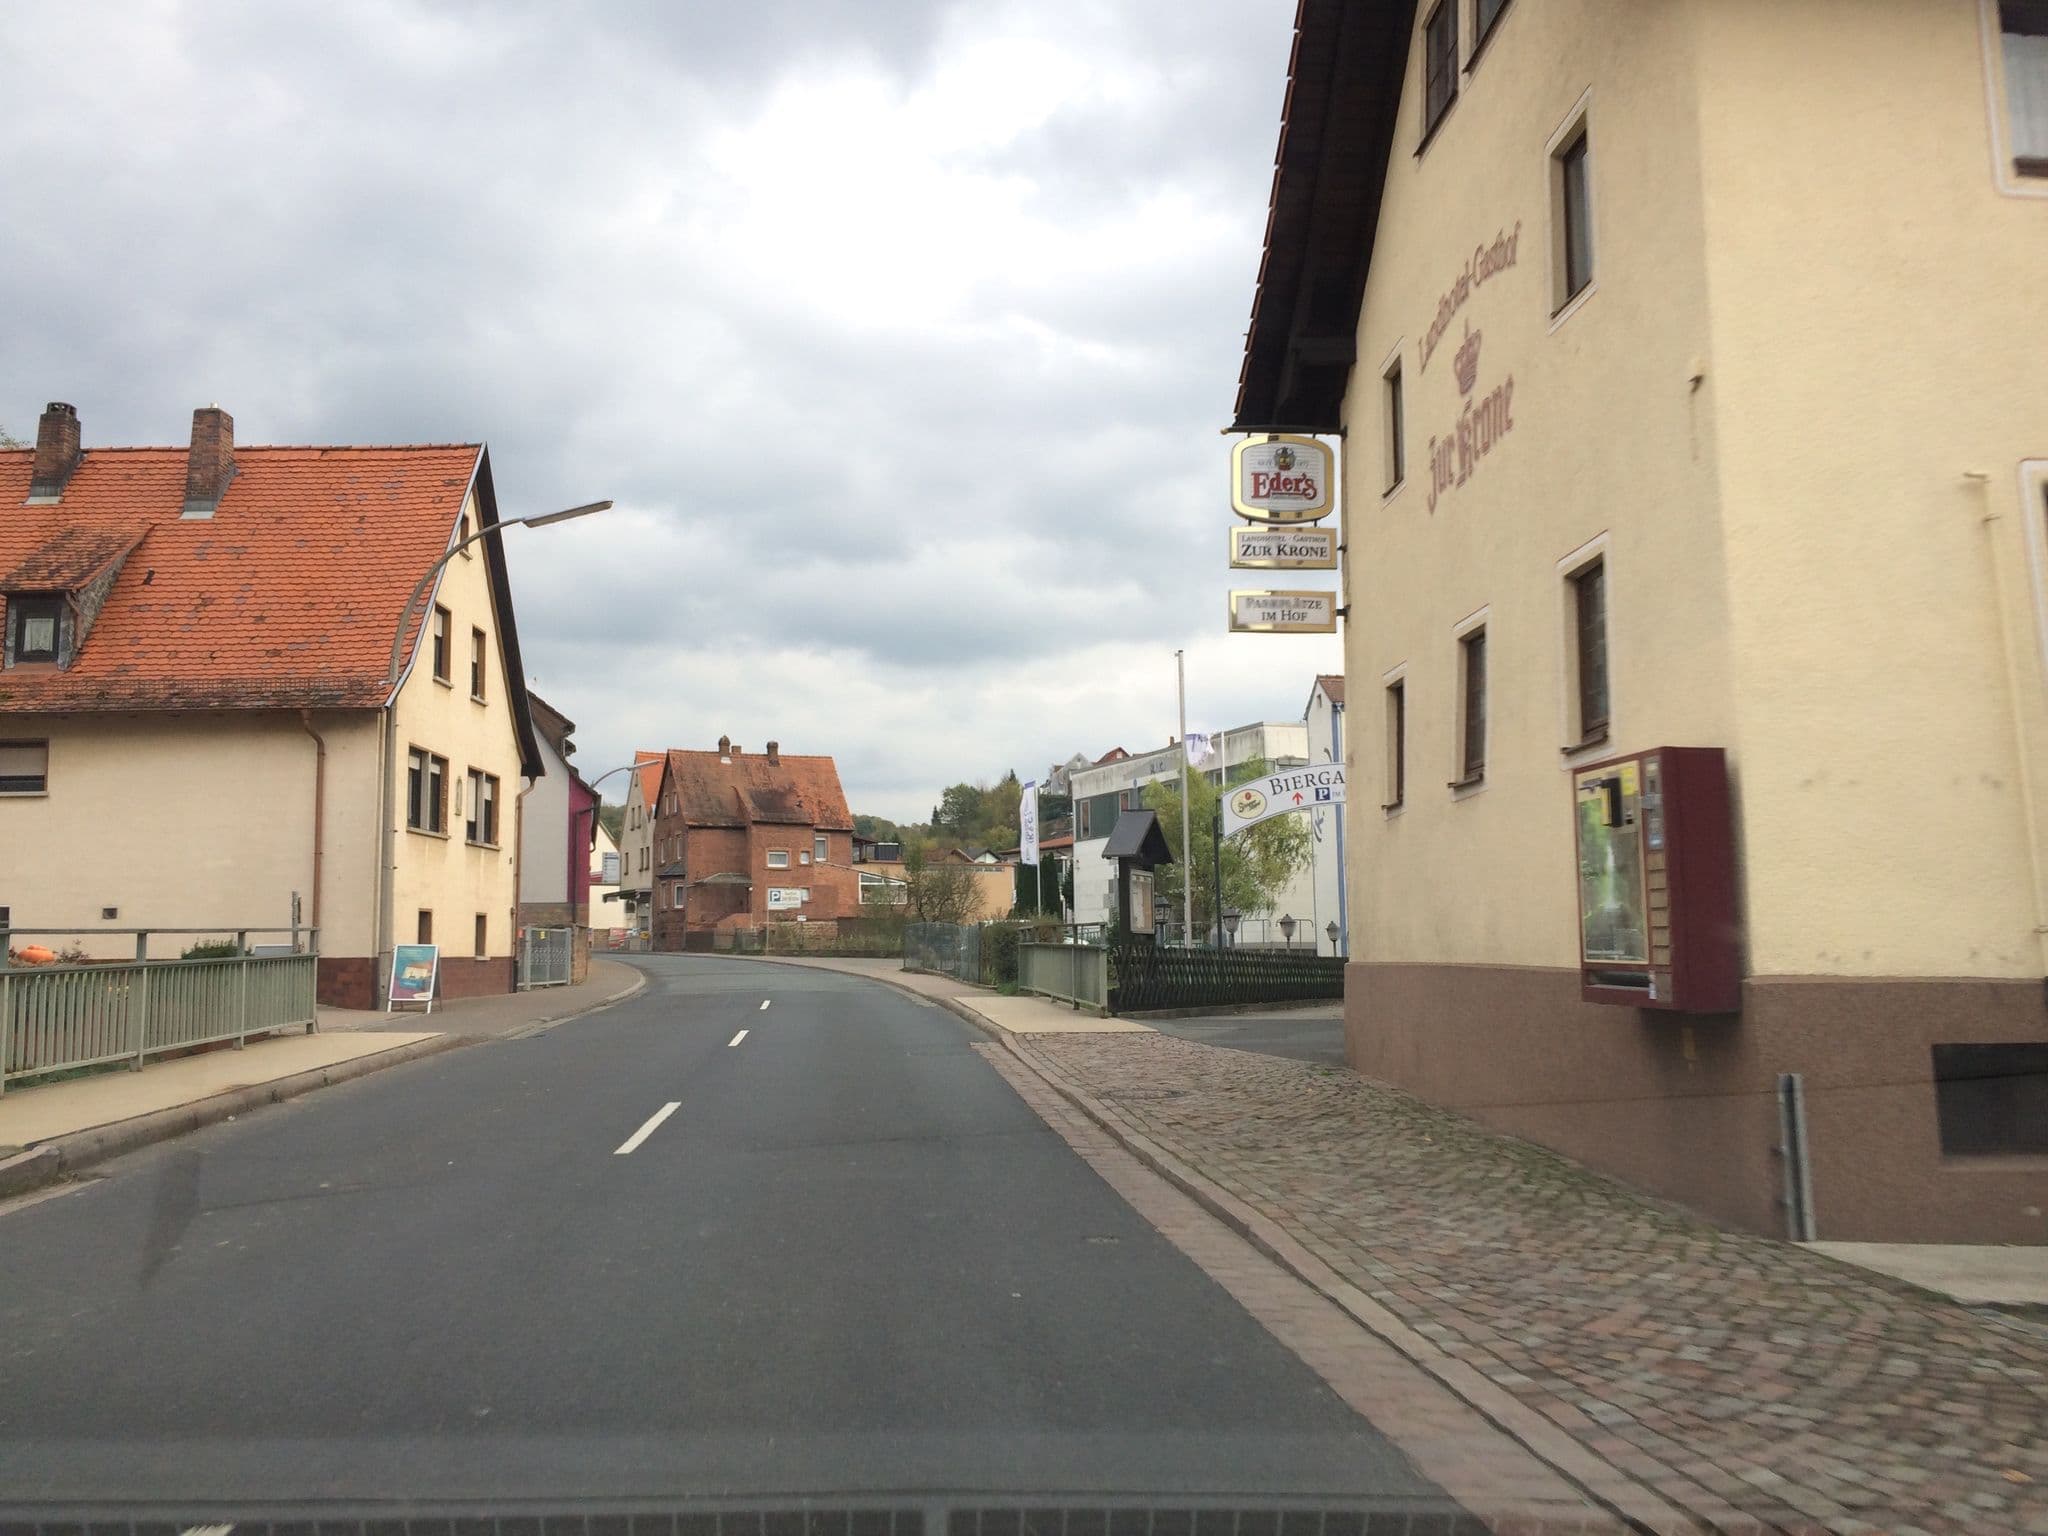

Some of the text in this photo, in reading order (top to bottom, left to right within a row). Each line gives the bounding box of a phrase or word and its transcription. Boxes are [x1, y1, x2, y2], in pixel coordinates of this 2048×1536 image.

[1251, 471, 1317, 500] Eder's
[1241, 543, 1328, 558] ZUR KRONE
[1281, 609, 1308, 622] HOF
